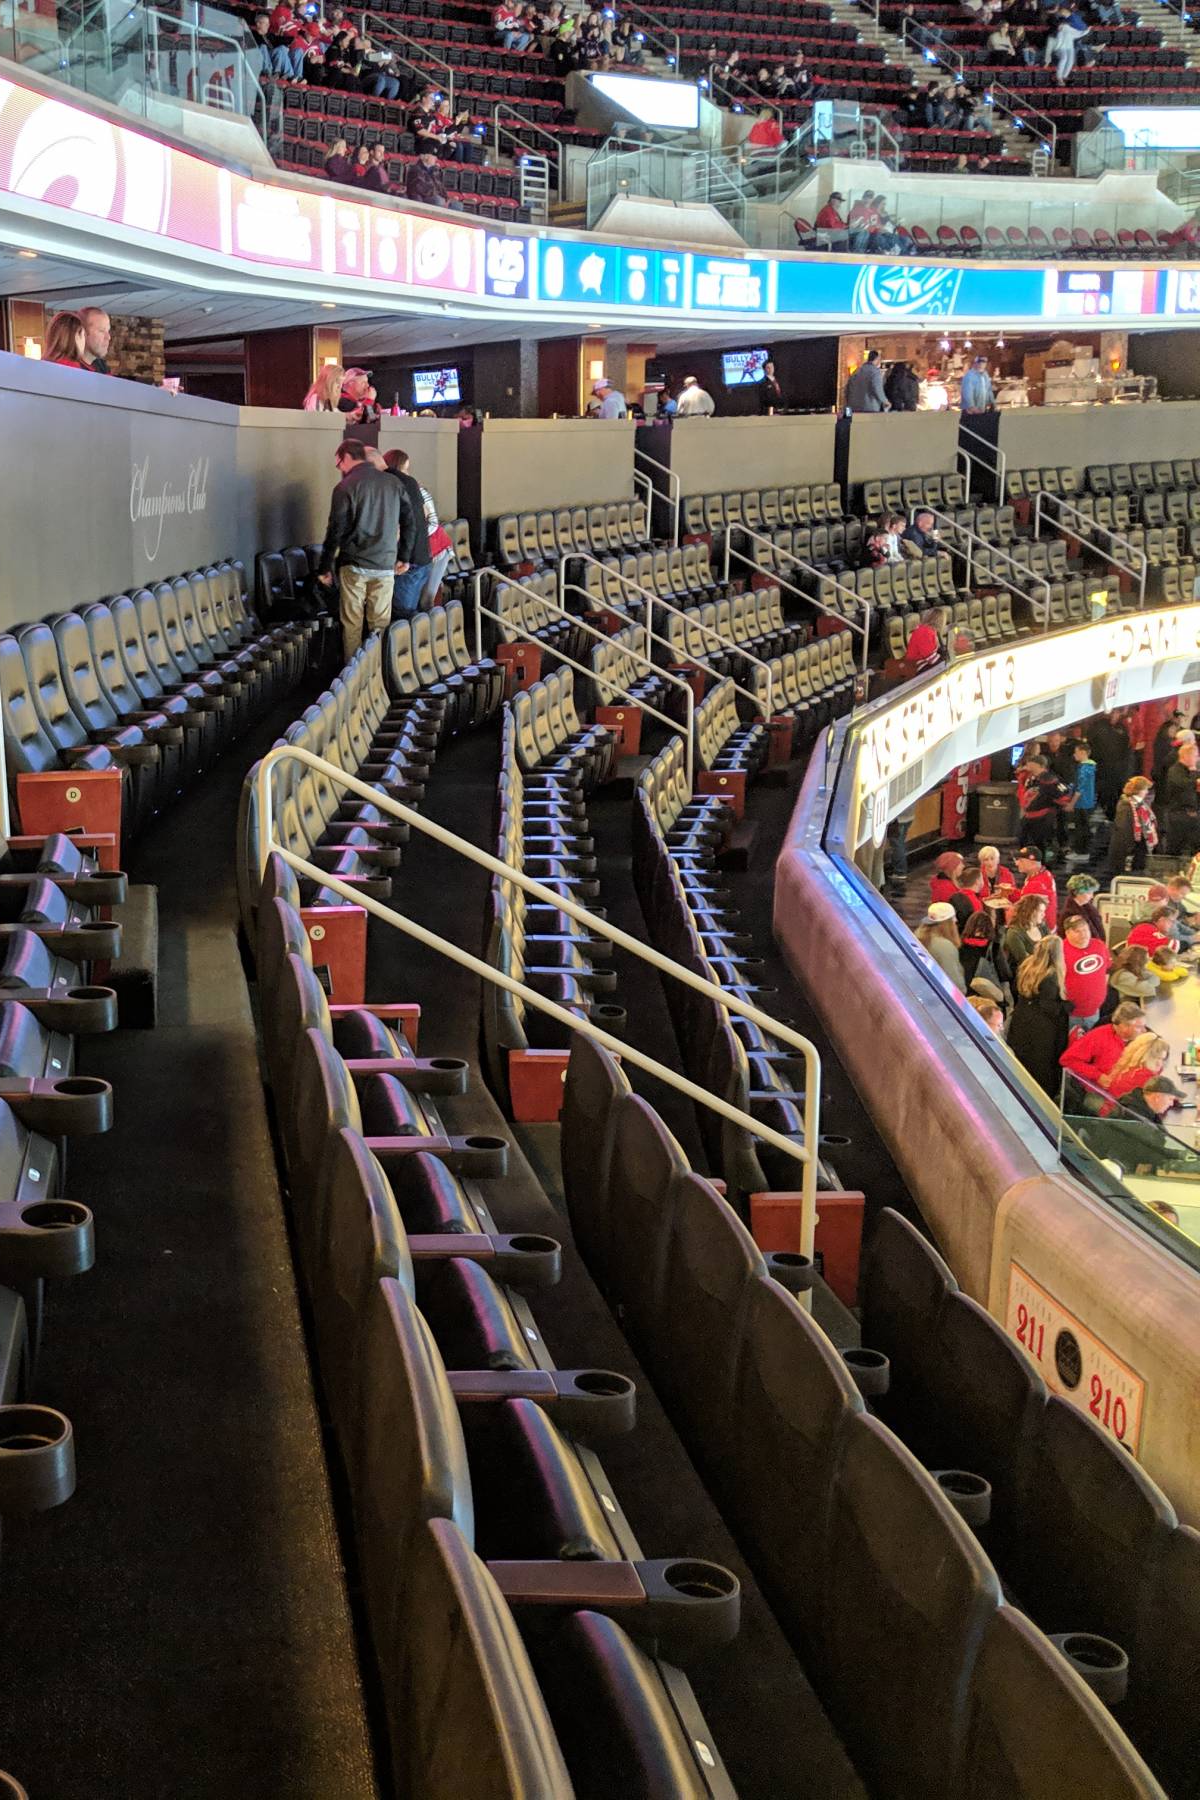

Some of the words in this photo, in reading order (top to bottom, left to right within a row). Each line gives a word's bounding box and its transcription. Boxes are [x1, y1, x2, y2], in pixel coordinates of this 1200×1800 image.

[130, 455, 186, 560] Champions
[187, 455, 210, 515] Club
[1015, 1303, 1045, 1362] 211
[1088, 1374, 1128, 1441] 210
